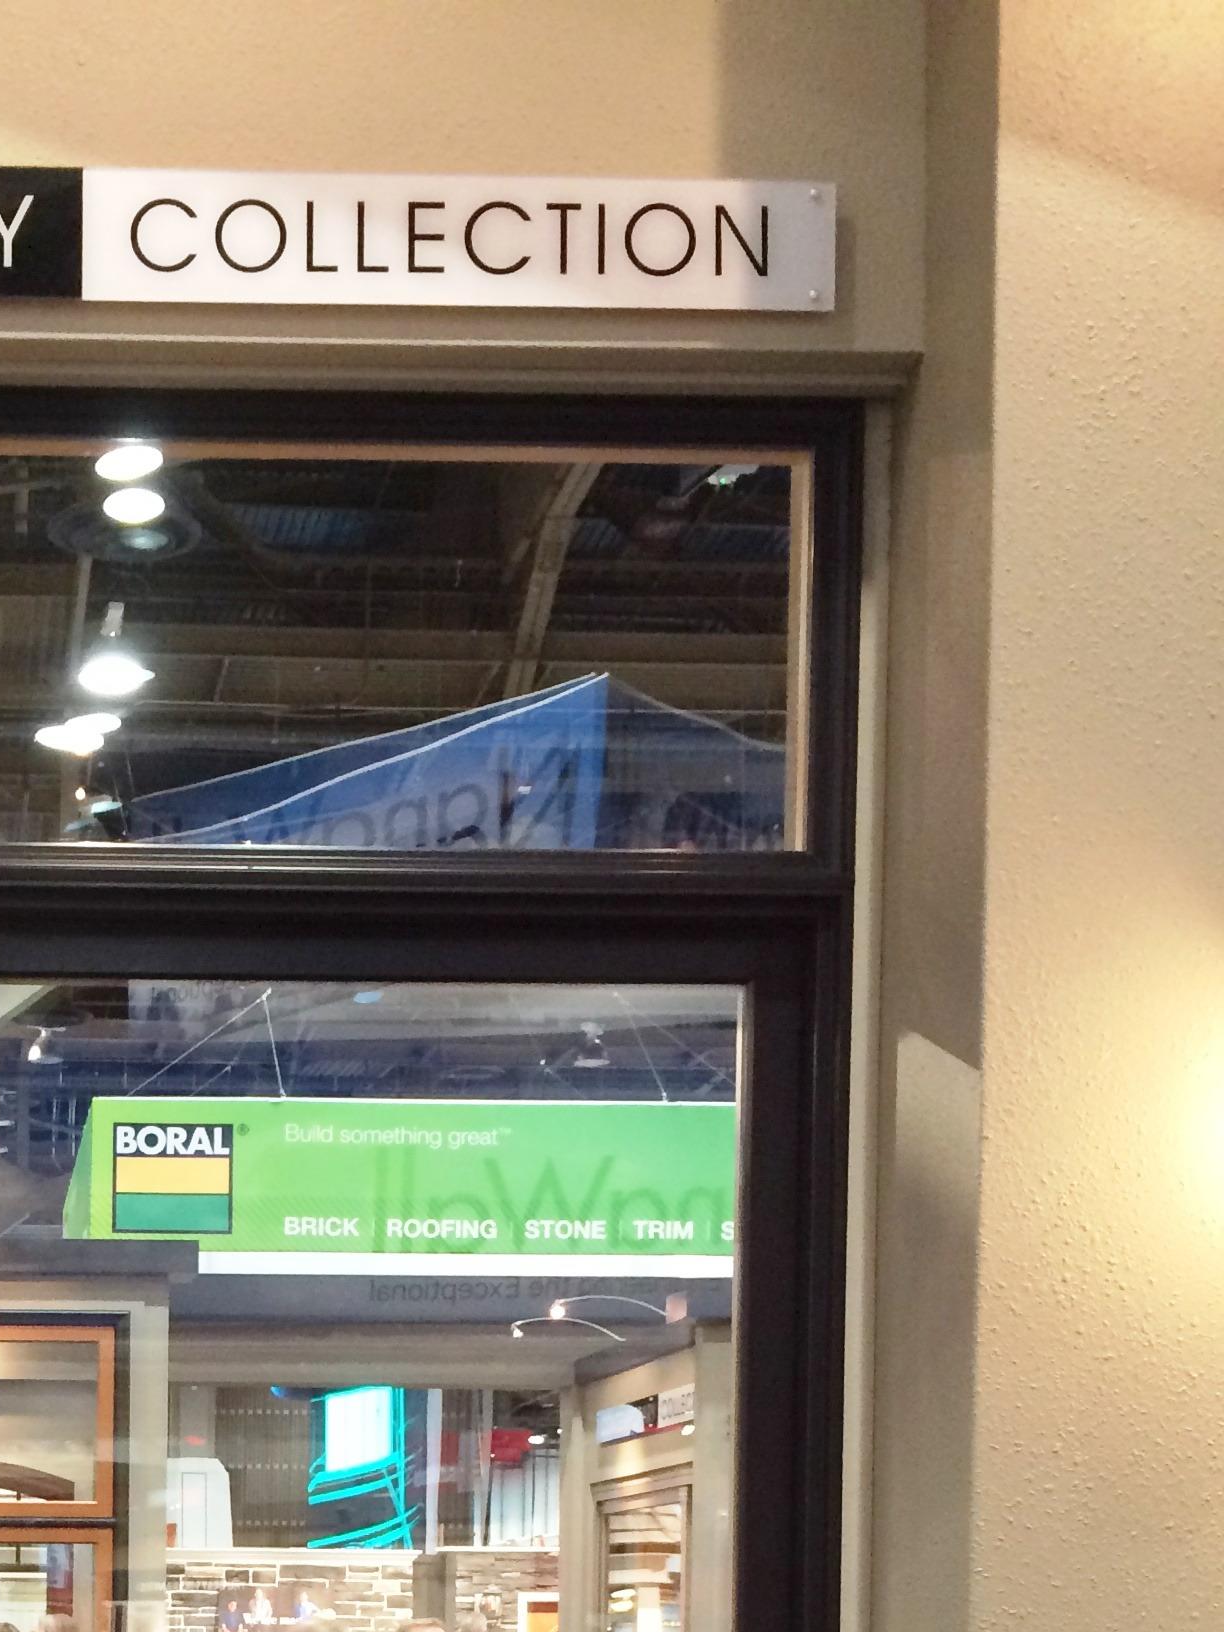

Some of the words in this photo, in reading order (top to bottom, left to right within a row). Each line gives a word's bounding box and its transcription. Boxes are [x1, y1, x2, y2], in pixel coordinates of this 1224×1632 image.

[130, 198, 769, 278] COLLECTION
[115, 1126, 230, 1156] BORAL
[285, 1123, 334, 1143] Build
[339, 1125, 442, 1149] something
[283, 1216, 360, 1237] BRICK
[386, 1217, 498, 1239] ROOFING
[524, 1219, 608, 1240] STONE
[633, 1220, 694, 1240] TRIM
